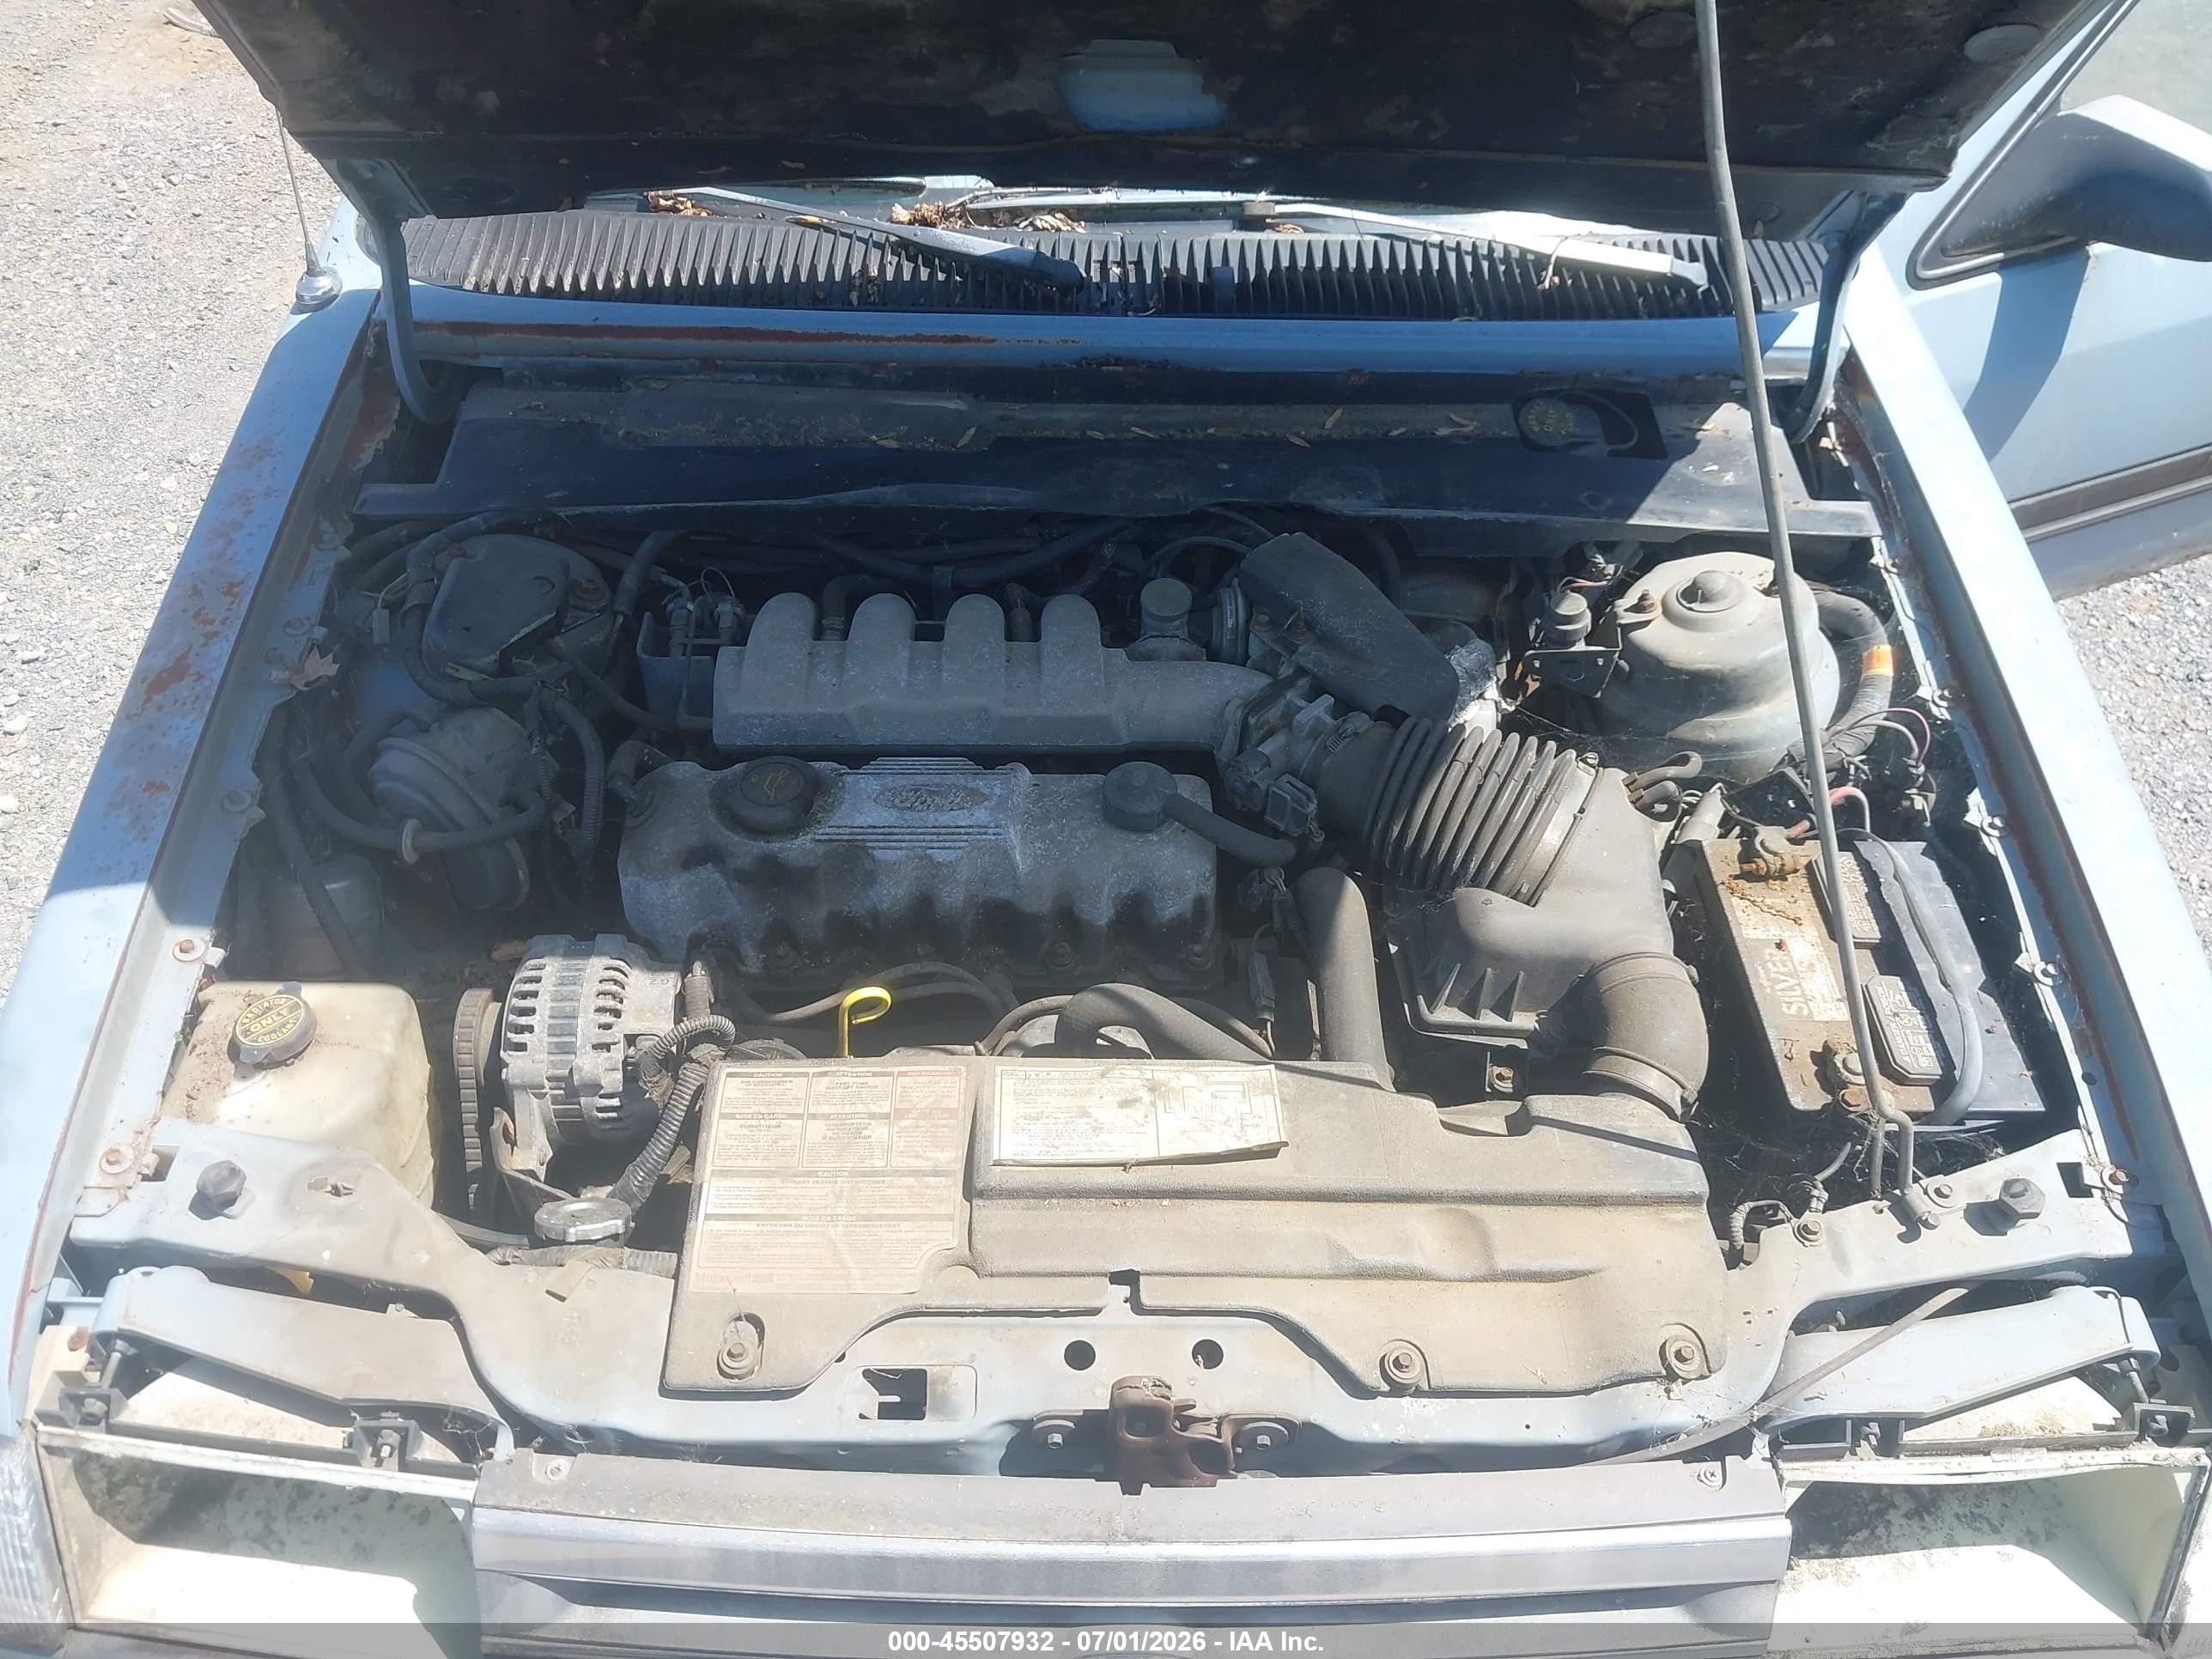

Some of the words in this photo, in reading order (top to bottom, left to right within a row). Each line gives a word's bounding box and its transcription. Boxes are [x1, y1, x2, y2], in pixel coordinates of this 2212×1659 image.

[1875, 986, 1893, 1015] POISON
[250, 1008, 288, 1032] ONLY
[258, 1018, 297, 1042] COOLANT
[1890, 1022, 1909, 1055] DANGER
